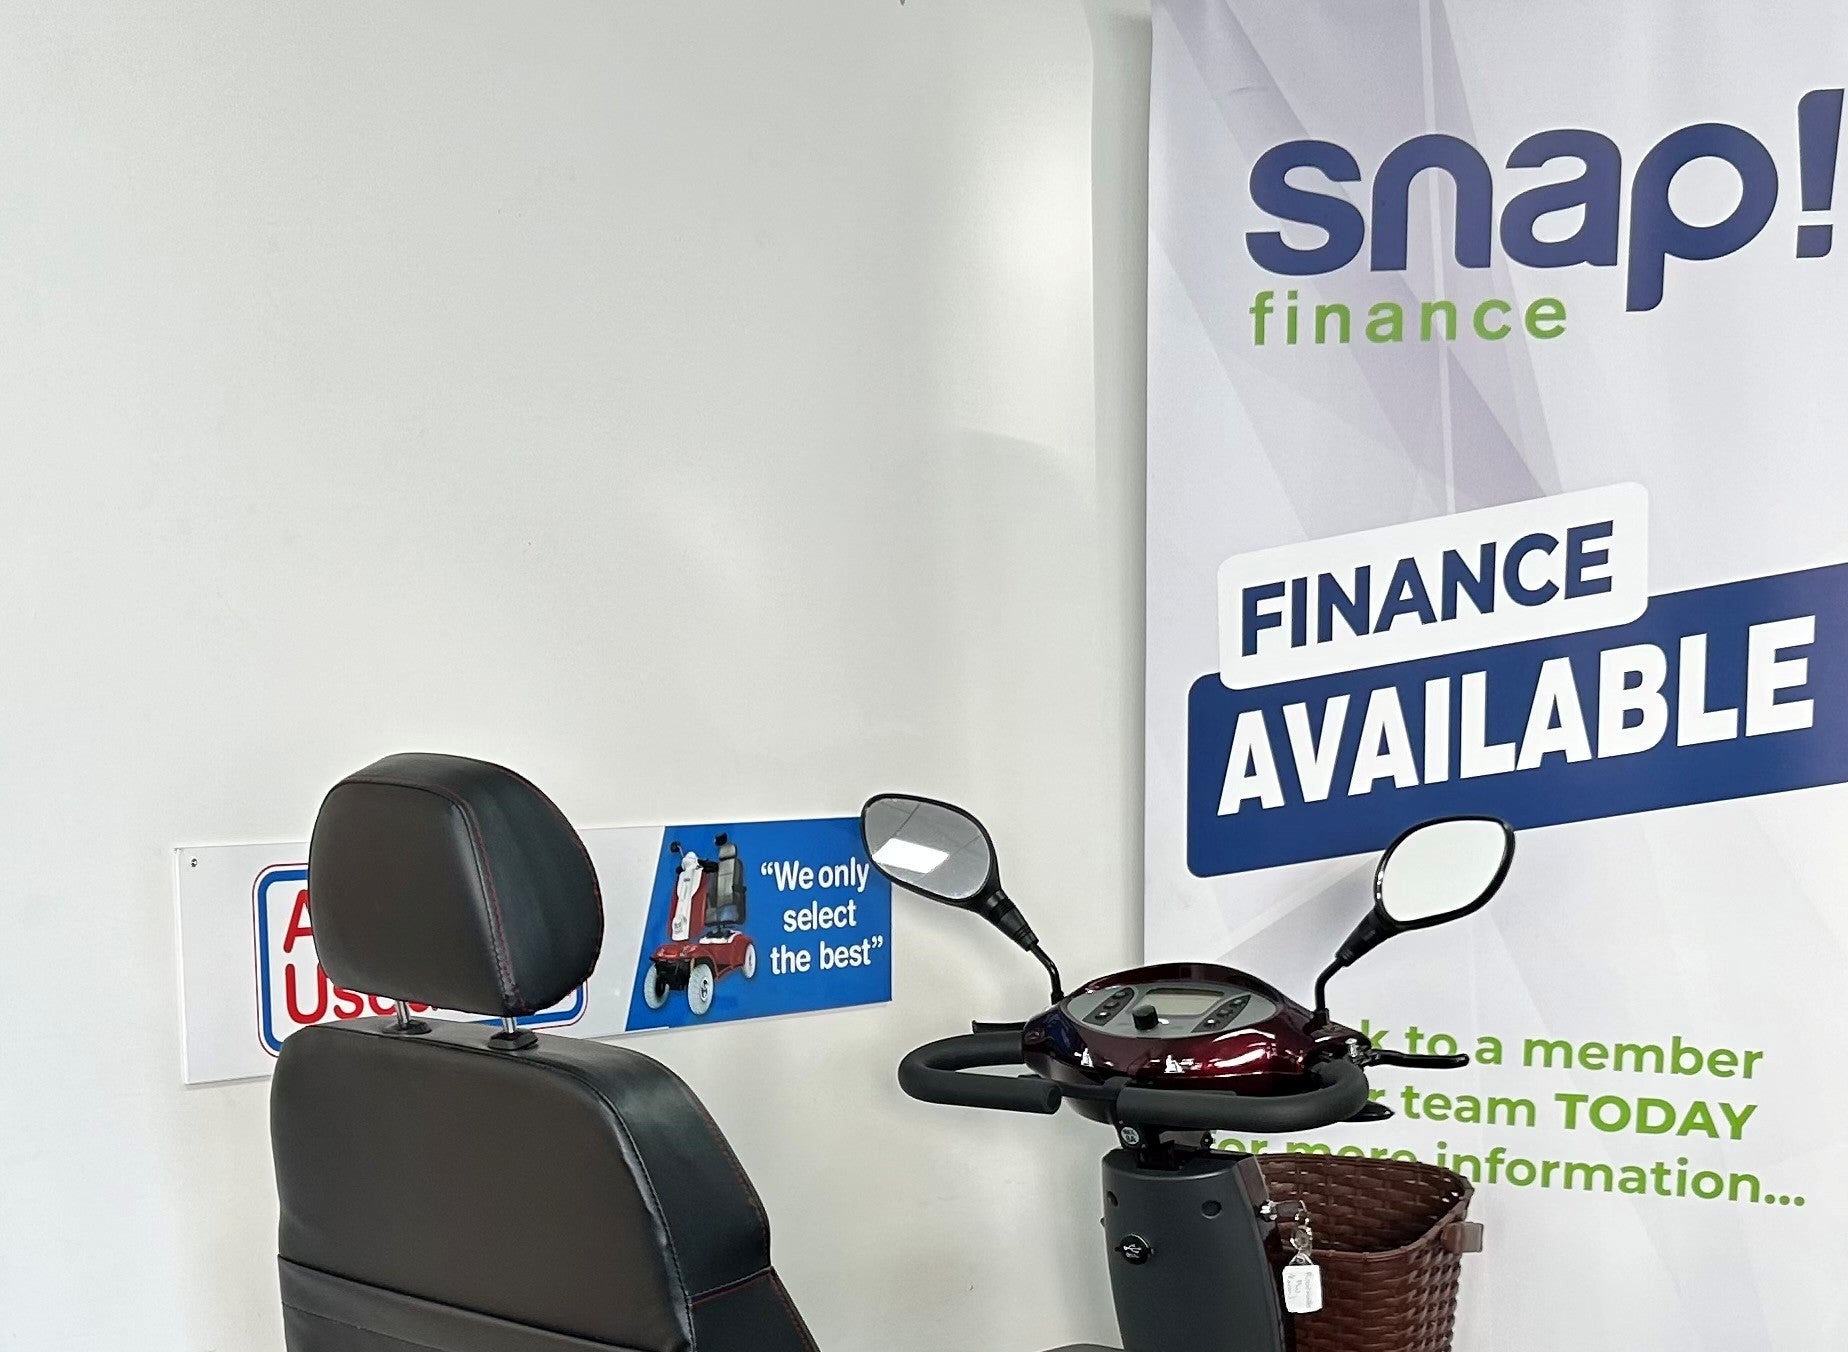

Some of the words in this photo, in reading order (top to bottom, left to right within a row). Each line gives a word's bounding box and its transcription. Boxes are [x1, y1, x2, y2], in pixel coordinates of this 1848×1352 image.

[1245, 88, 1845, 312] snap!
[1249, 290, 1567, 346] finance
[1241, 519, 1615, 658] FINANCE
[1216, 615, 1816, 818] AVAILABLE
[818, 856, 870, 893] only
[783, 899, 857, 933] select
[769, 944, 812, 975] the
[1405, 1026, 1459, 1056] to
[1474, 1035, 1504, 1066] a
[1521, 1035, 1765, 1080] member
[1401, 1086, 1537, 1127] team
[1554, 1093, 1759, 1142] TODAY
